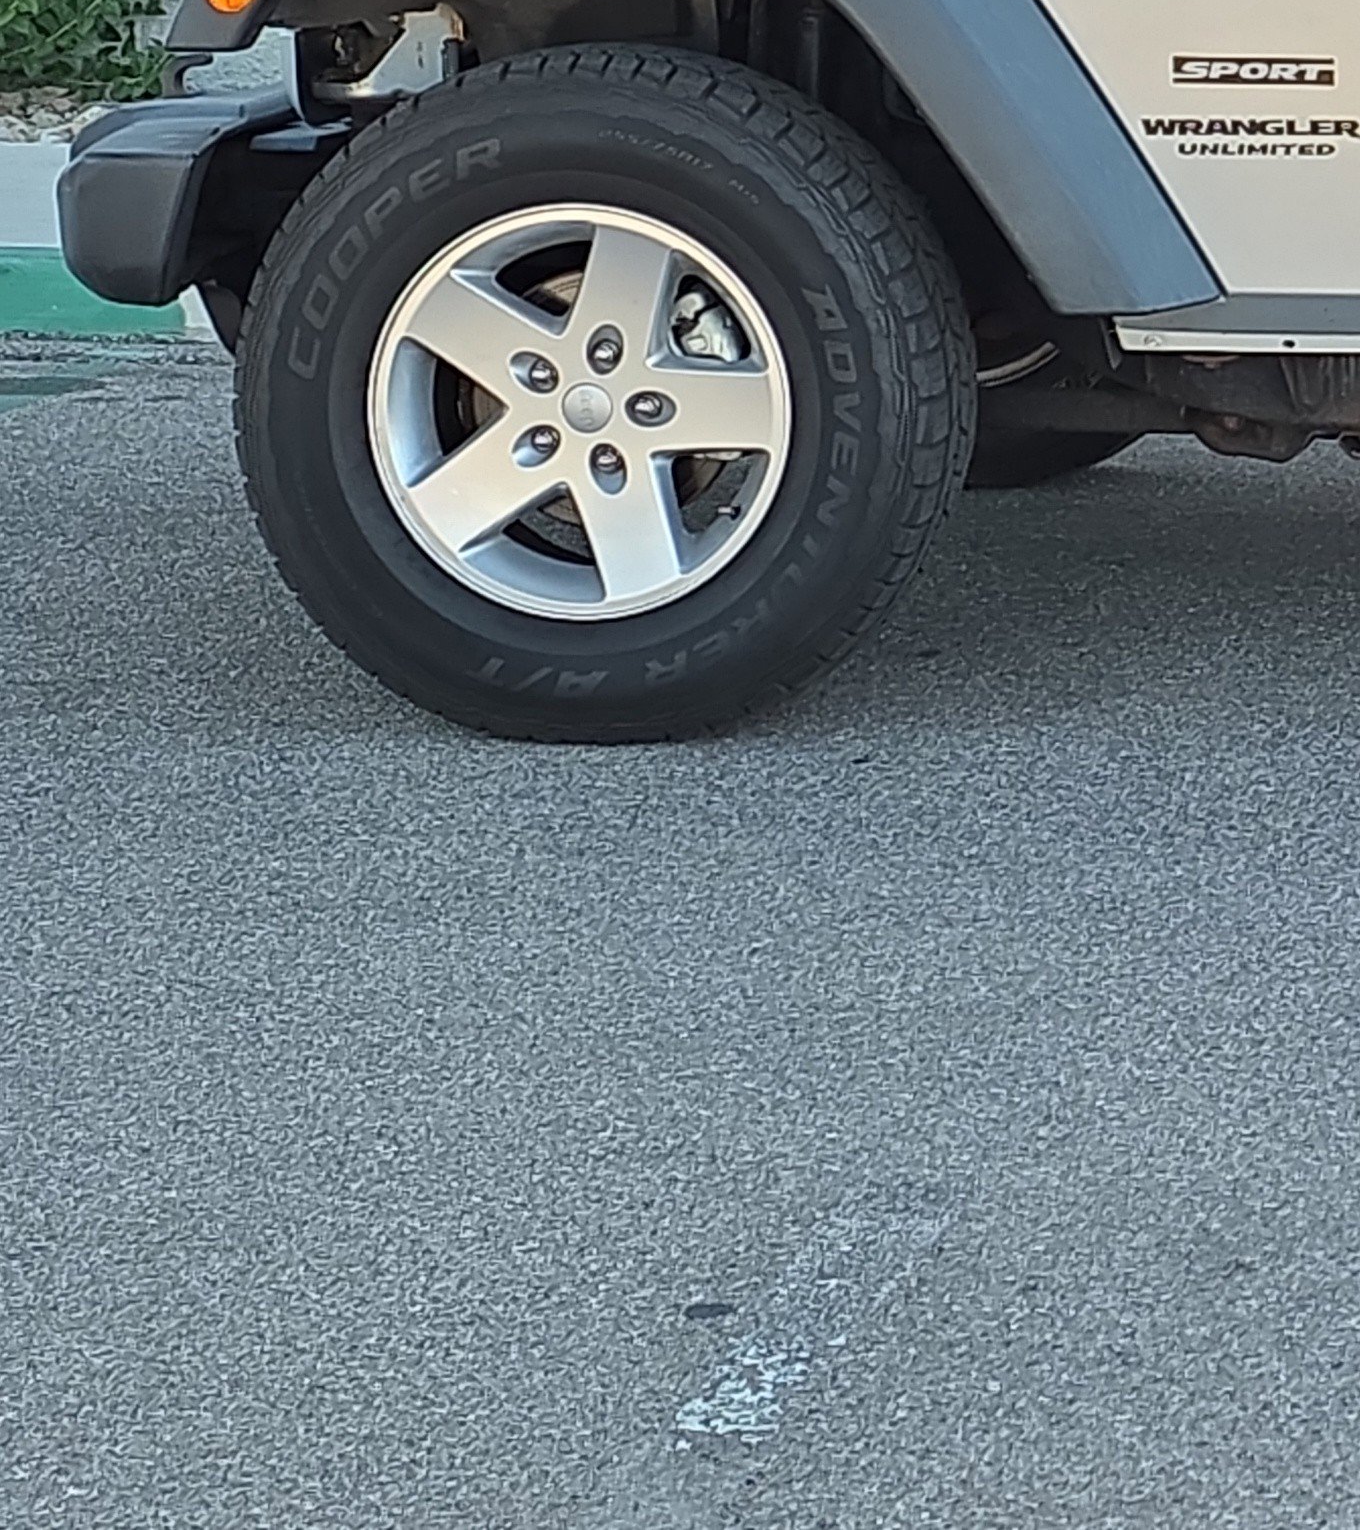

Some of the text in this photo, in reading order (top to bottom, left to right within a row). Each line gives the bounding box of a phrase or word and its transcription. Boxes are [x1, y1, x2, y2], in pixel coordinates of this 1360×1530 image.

[1176, 61, 1334, 82] SPORT
[1177, 142, 1337, 157] UNLIMITED
[287, 137, 502, 381] COOPER
[644, 283, 864, 687] ADVENTURER
[468, 655, 612, 699] A/T
